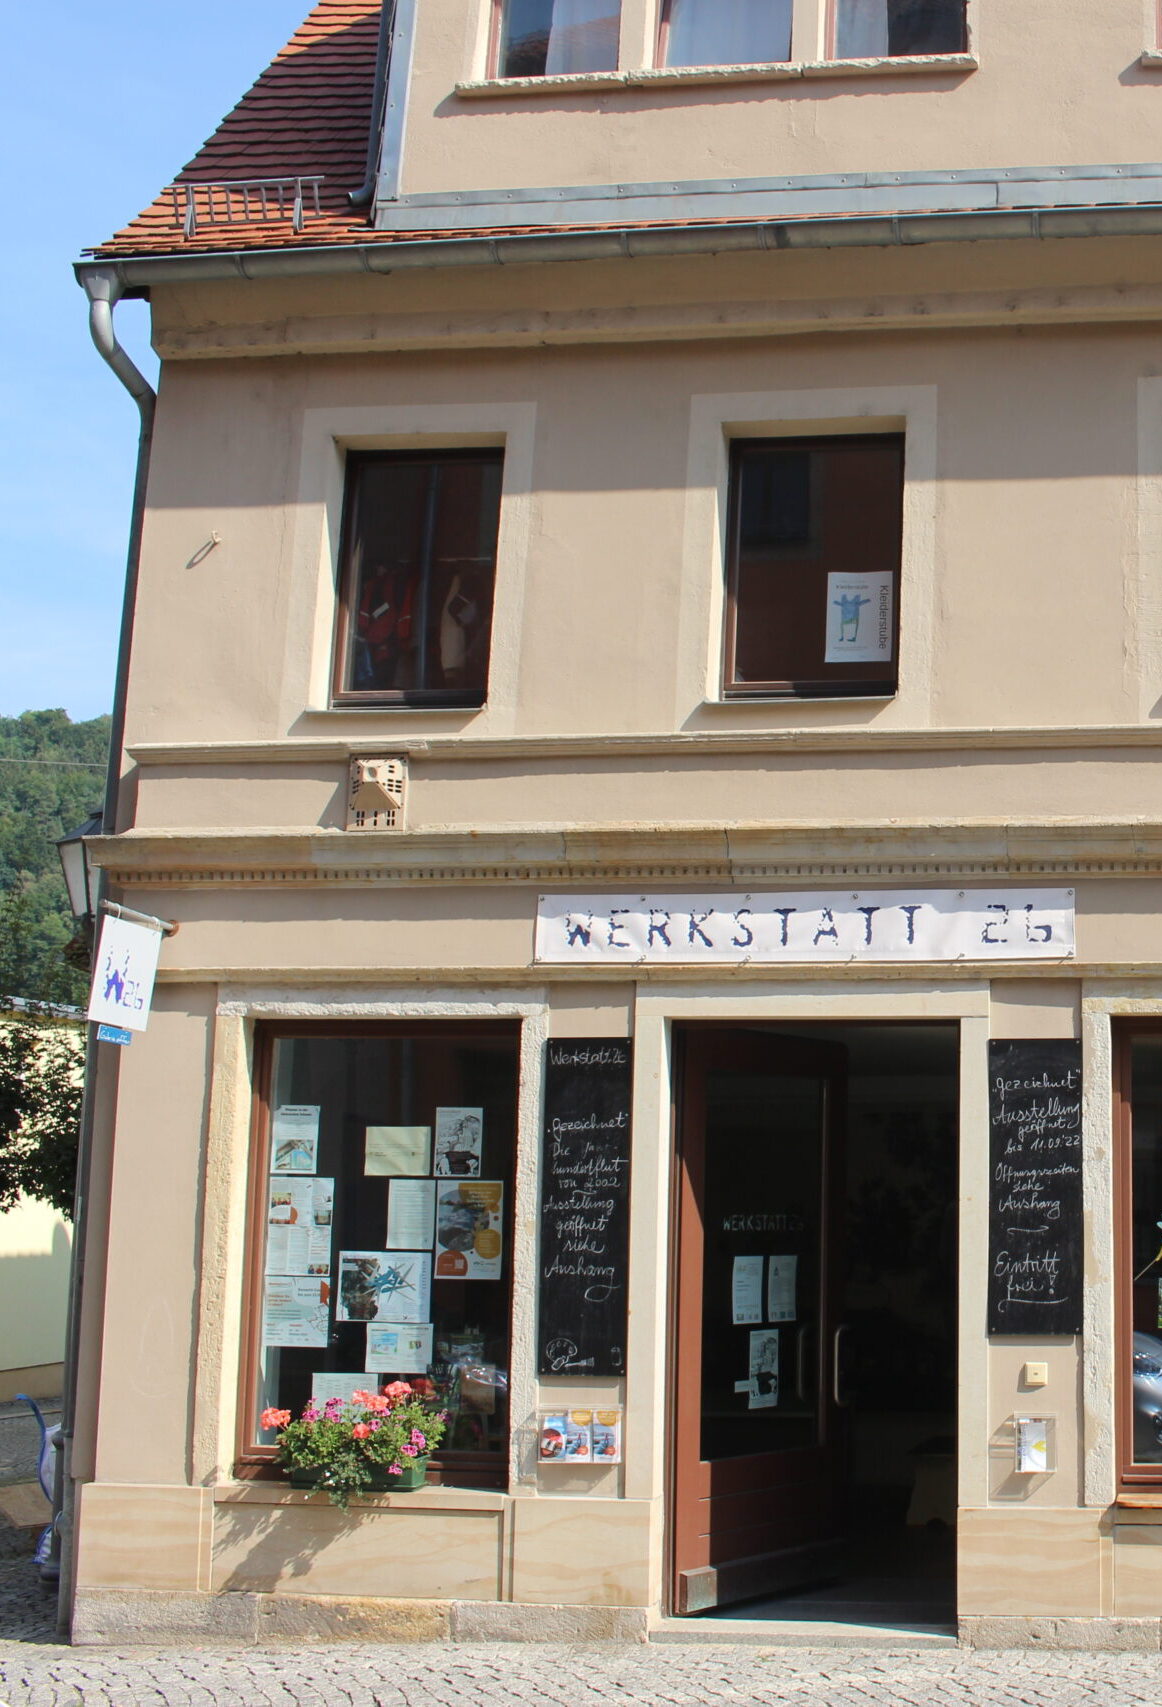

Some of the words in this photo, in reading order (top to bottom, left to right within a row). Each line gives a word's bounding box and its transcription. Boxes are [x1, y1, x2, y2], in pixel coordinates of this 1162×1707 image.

[878, 585, 888, 649] Kleiderstube
[565, 905, 922, 948] WERKSTATT
[980, 904, 1053, 944] 26
[992, 1097, 1080, 1129] Ausstellung
[1005, 1138, 1022, 1155] bis
[584, 1177, 620, 1188] 2002
[994, 1250, 1060, 1277] Eintritt
